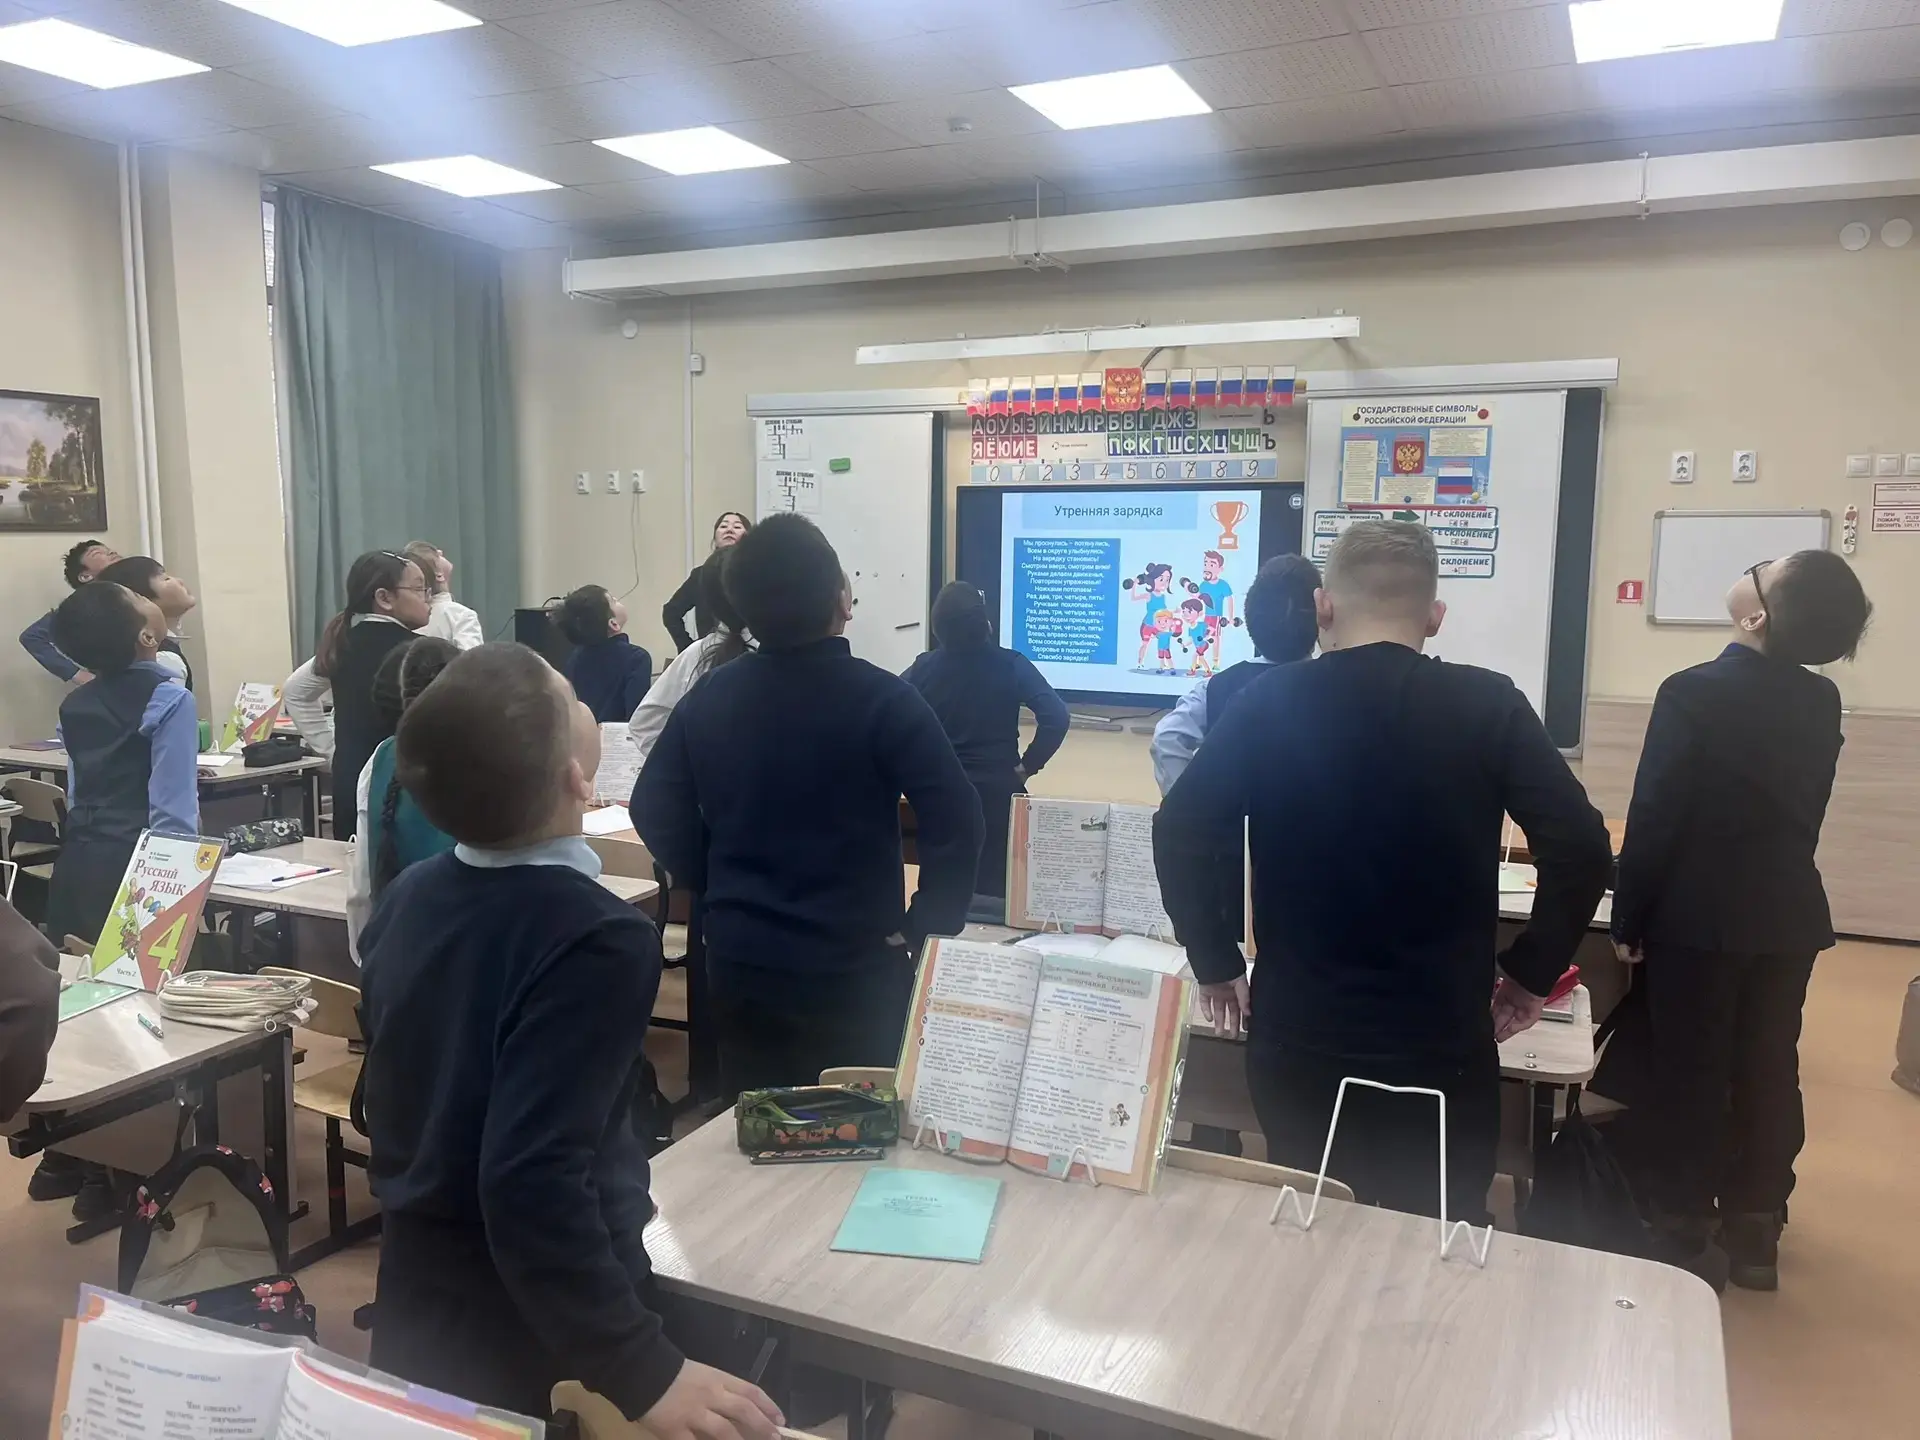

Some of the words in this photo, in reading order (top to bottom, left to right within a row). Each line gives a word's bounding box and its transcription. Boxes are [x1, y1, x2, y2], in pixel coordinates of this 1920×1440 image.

[1357, 405, 1433, 414] ГОСУДАРСТВЕННЫЕ
[1435, 405, 1478, 413] СИМВОЛЫ
[1364, 415, 1416, 424] РОССИЙСКОЙ
[1417, 415, 1467, 424] ФЕДЕРАЦИИ
[1054, 505, 1109, 518] Утренняя
[1113, 506, 1163, 518] зарядка
[133, 859, 178, 879] Русский
[148, 913, 188, 970] 4
